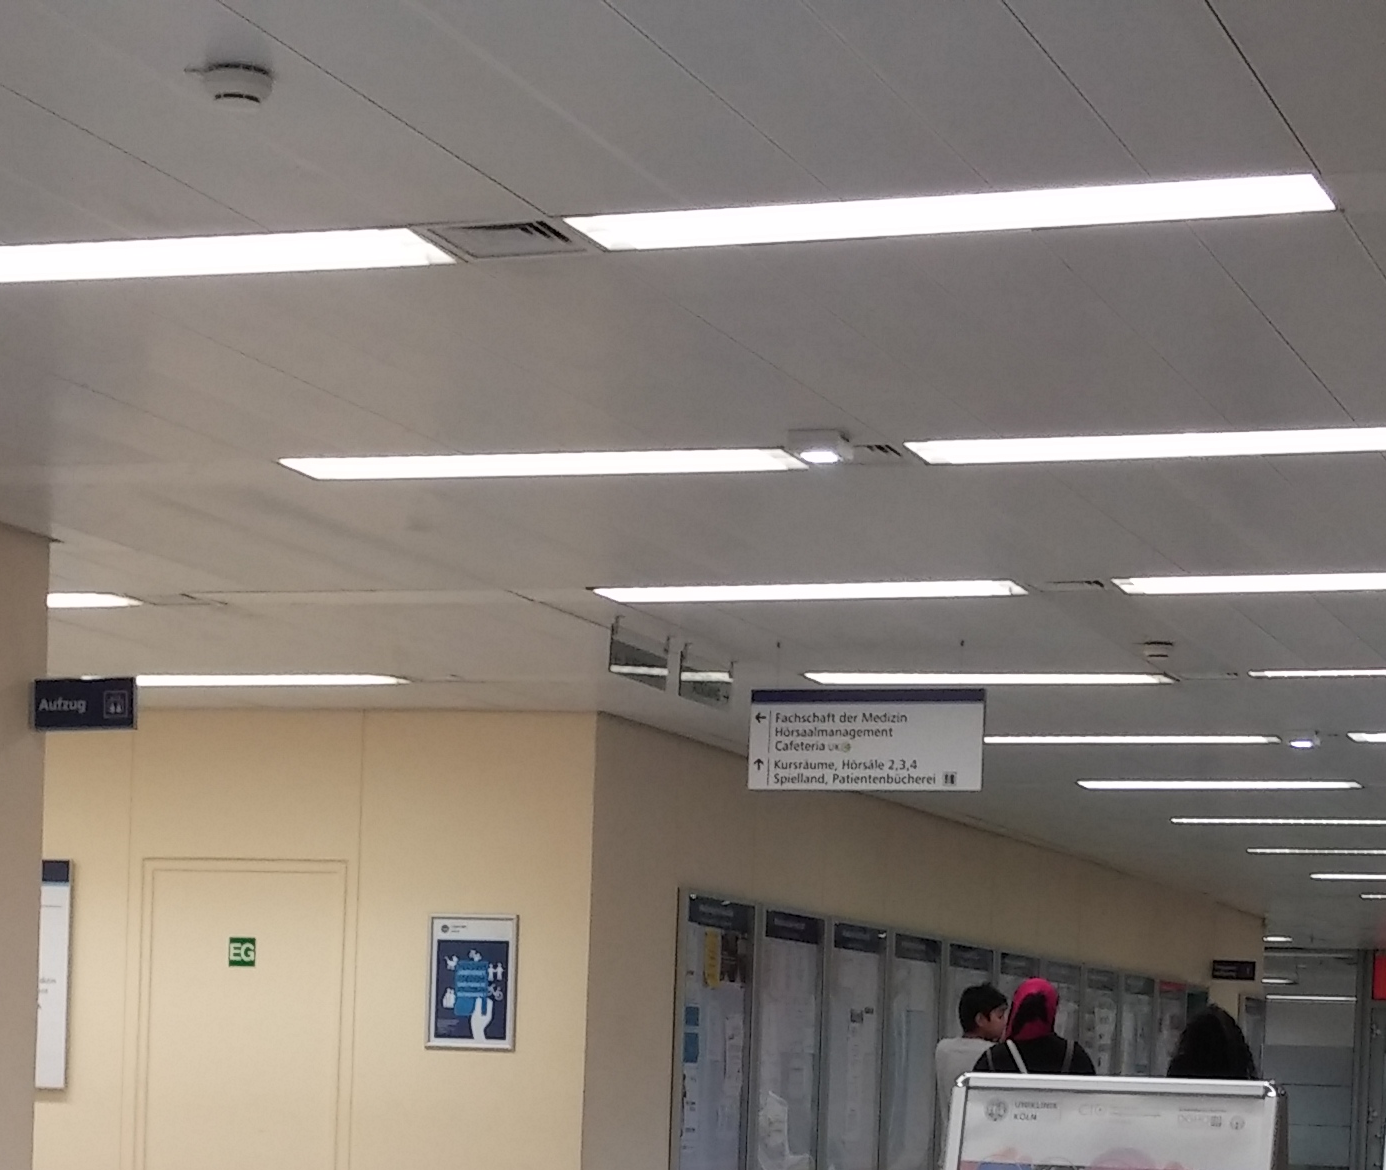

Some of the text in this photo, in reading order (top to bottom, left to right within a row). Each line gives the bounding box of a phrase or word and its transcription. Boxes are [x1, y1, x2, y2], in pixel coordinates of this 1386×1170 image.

[38, 697, 87, 714] Aufzug
[774, 712, 908, 723] Fachschaft der Medizin
[774, 727, 893, 739] Hörsaalmanagement
[774, 741, 825, 752] Cafeteria
[773, 758, 918, 772] Kursräume, Hörsäle 2,3,4
[773, 773, 936, 785] Spielland, Patientenbücherei
[229, 943, 255, 961] EG
